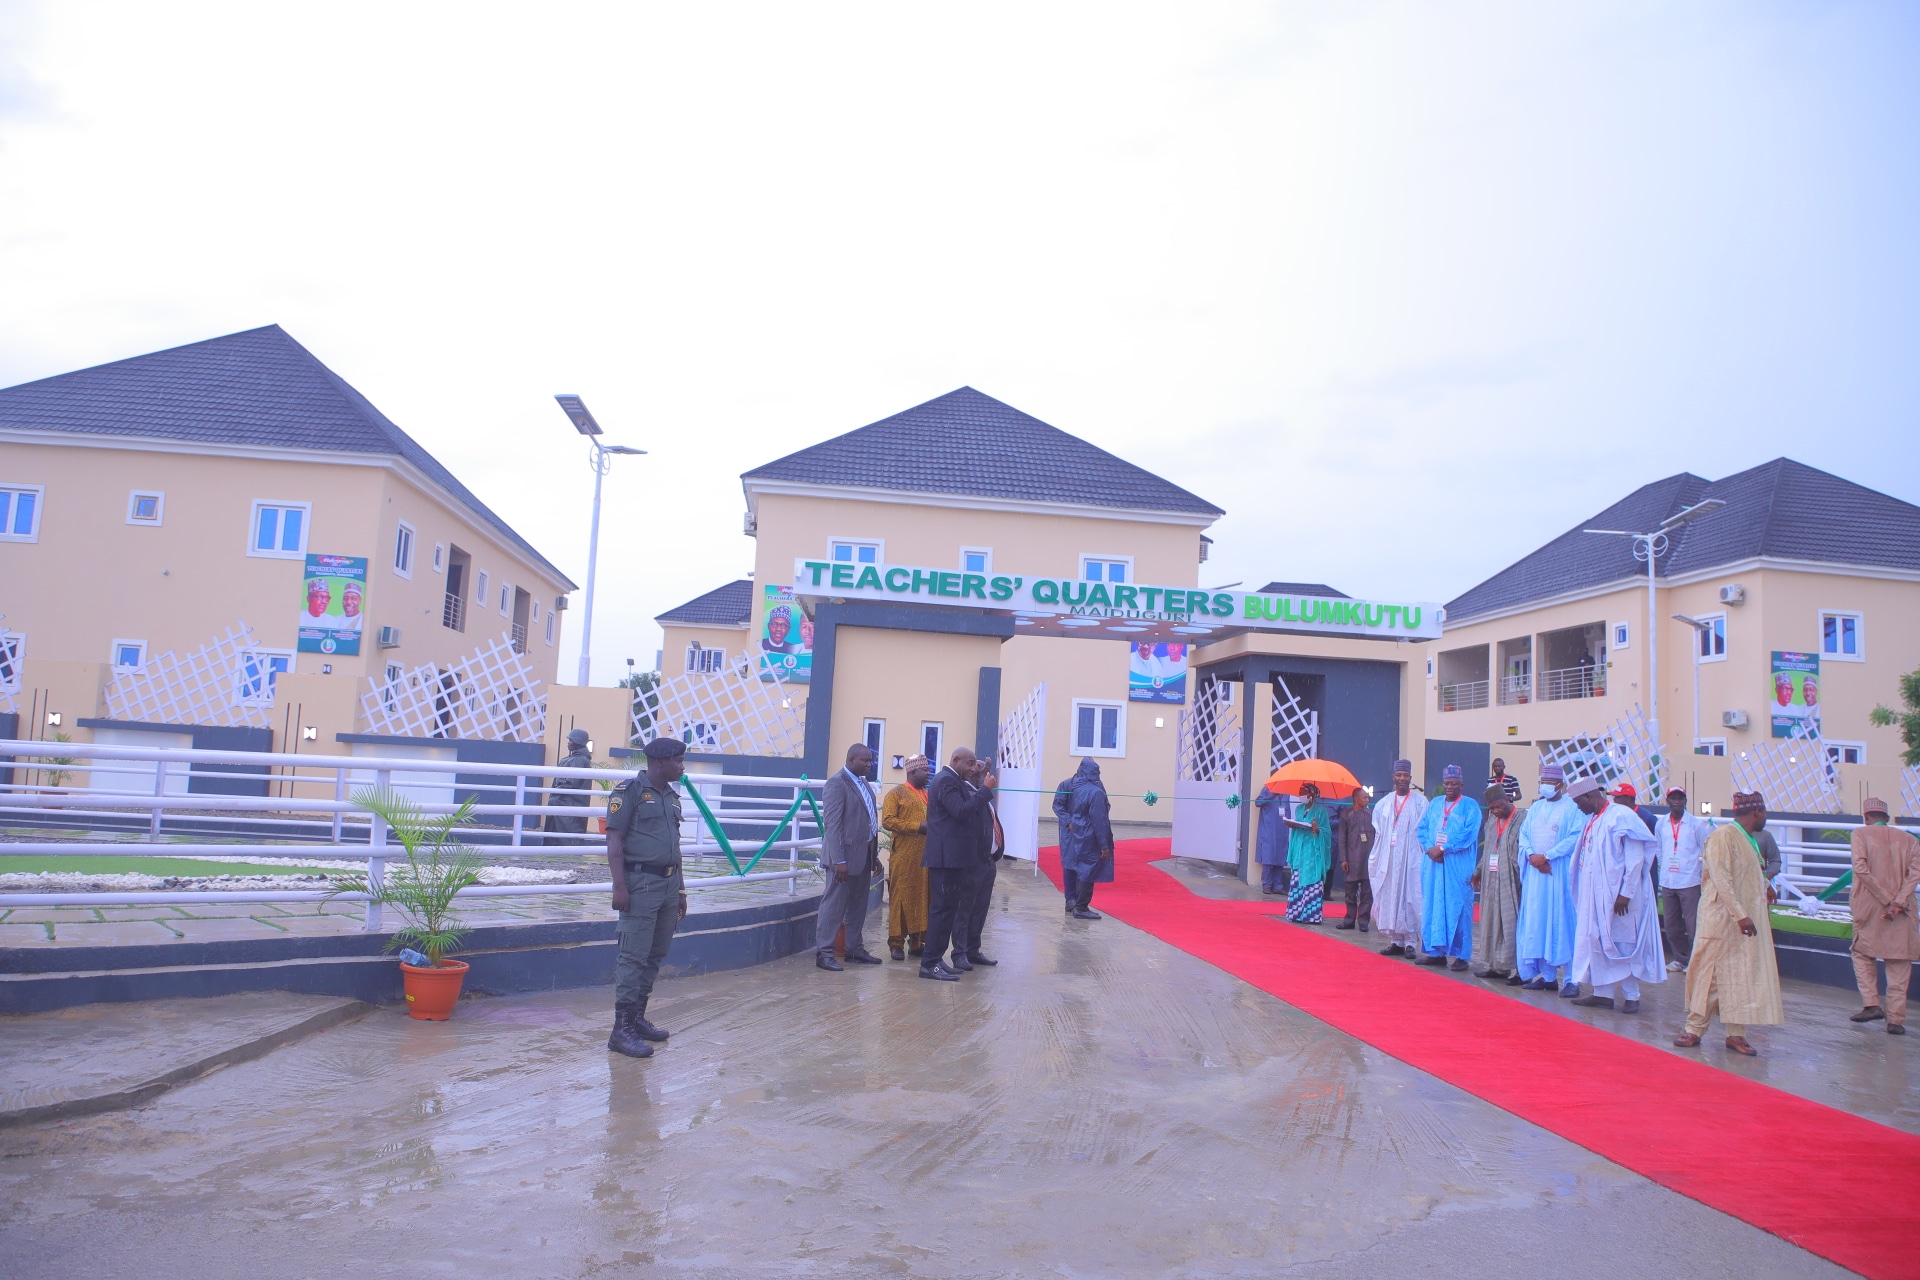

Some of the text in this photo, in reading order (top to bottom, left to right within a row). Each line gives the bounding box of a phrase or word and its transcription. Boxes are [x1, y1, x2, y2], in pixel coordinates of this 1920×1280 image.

[1032, 580, 1234, 617] QUARTERS
[1244, 595, 1422, 629] BULUMKUTU
[1070, 606, 1191, 622] MAIDUGURI
